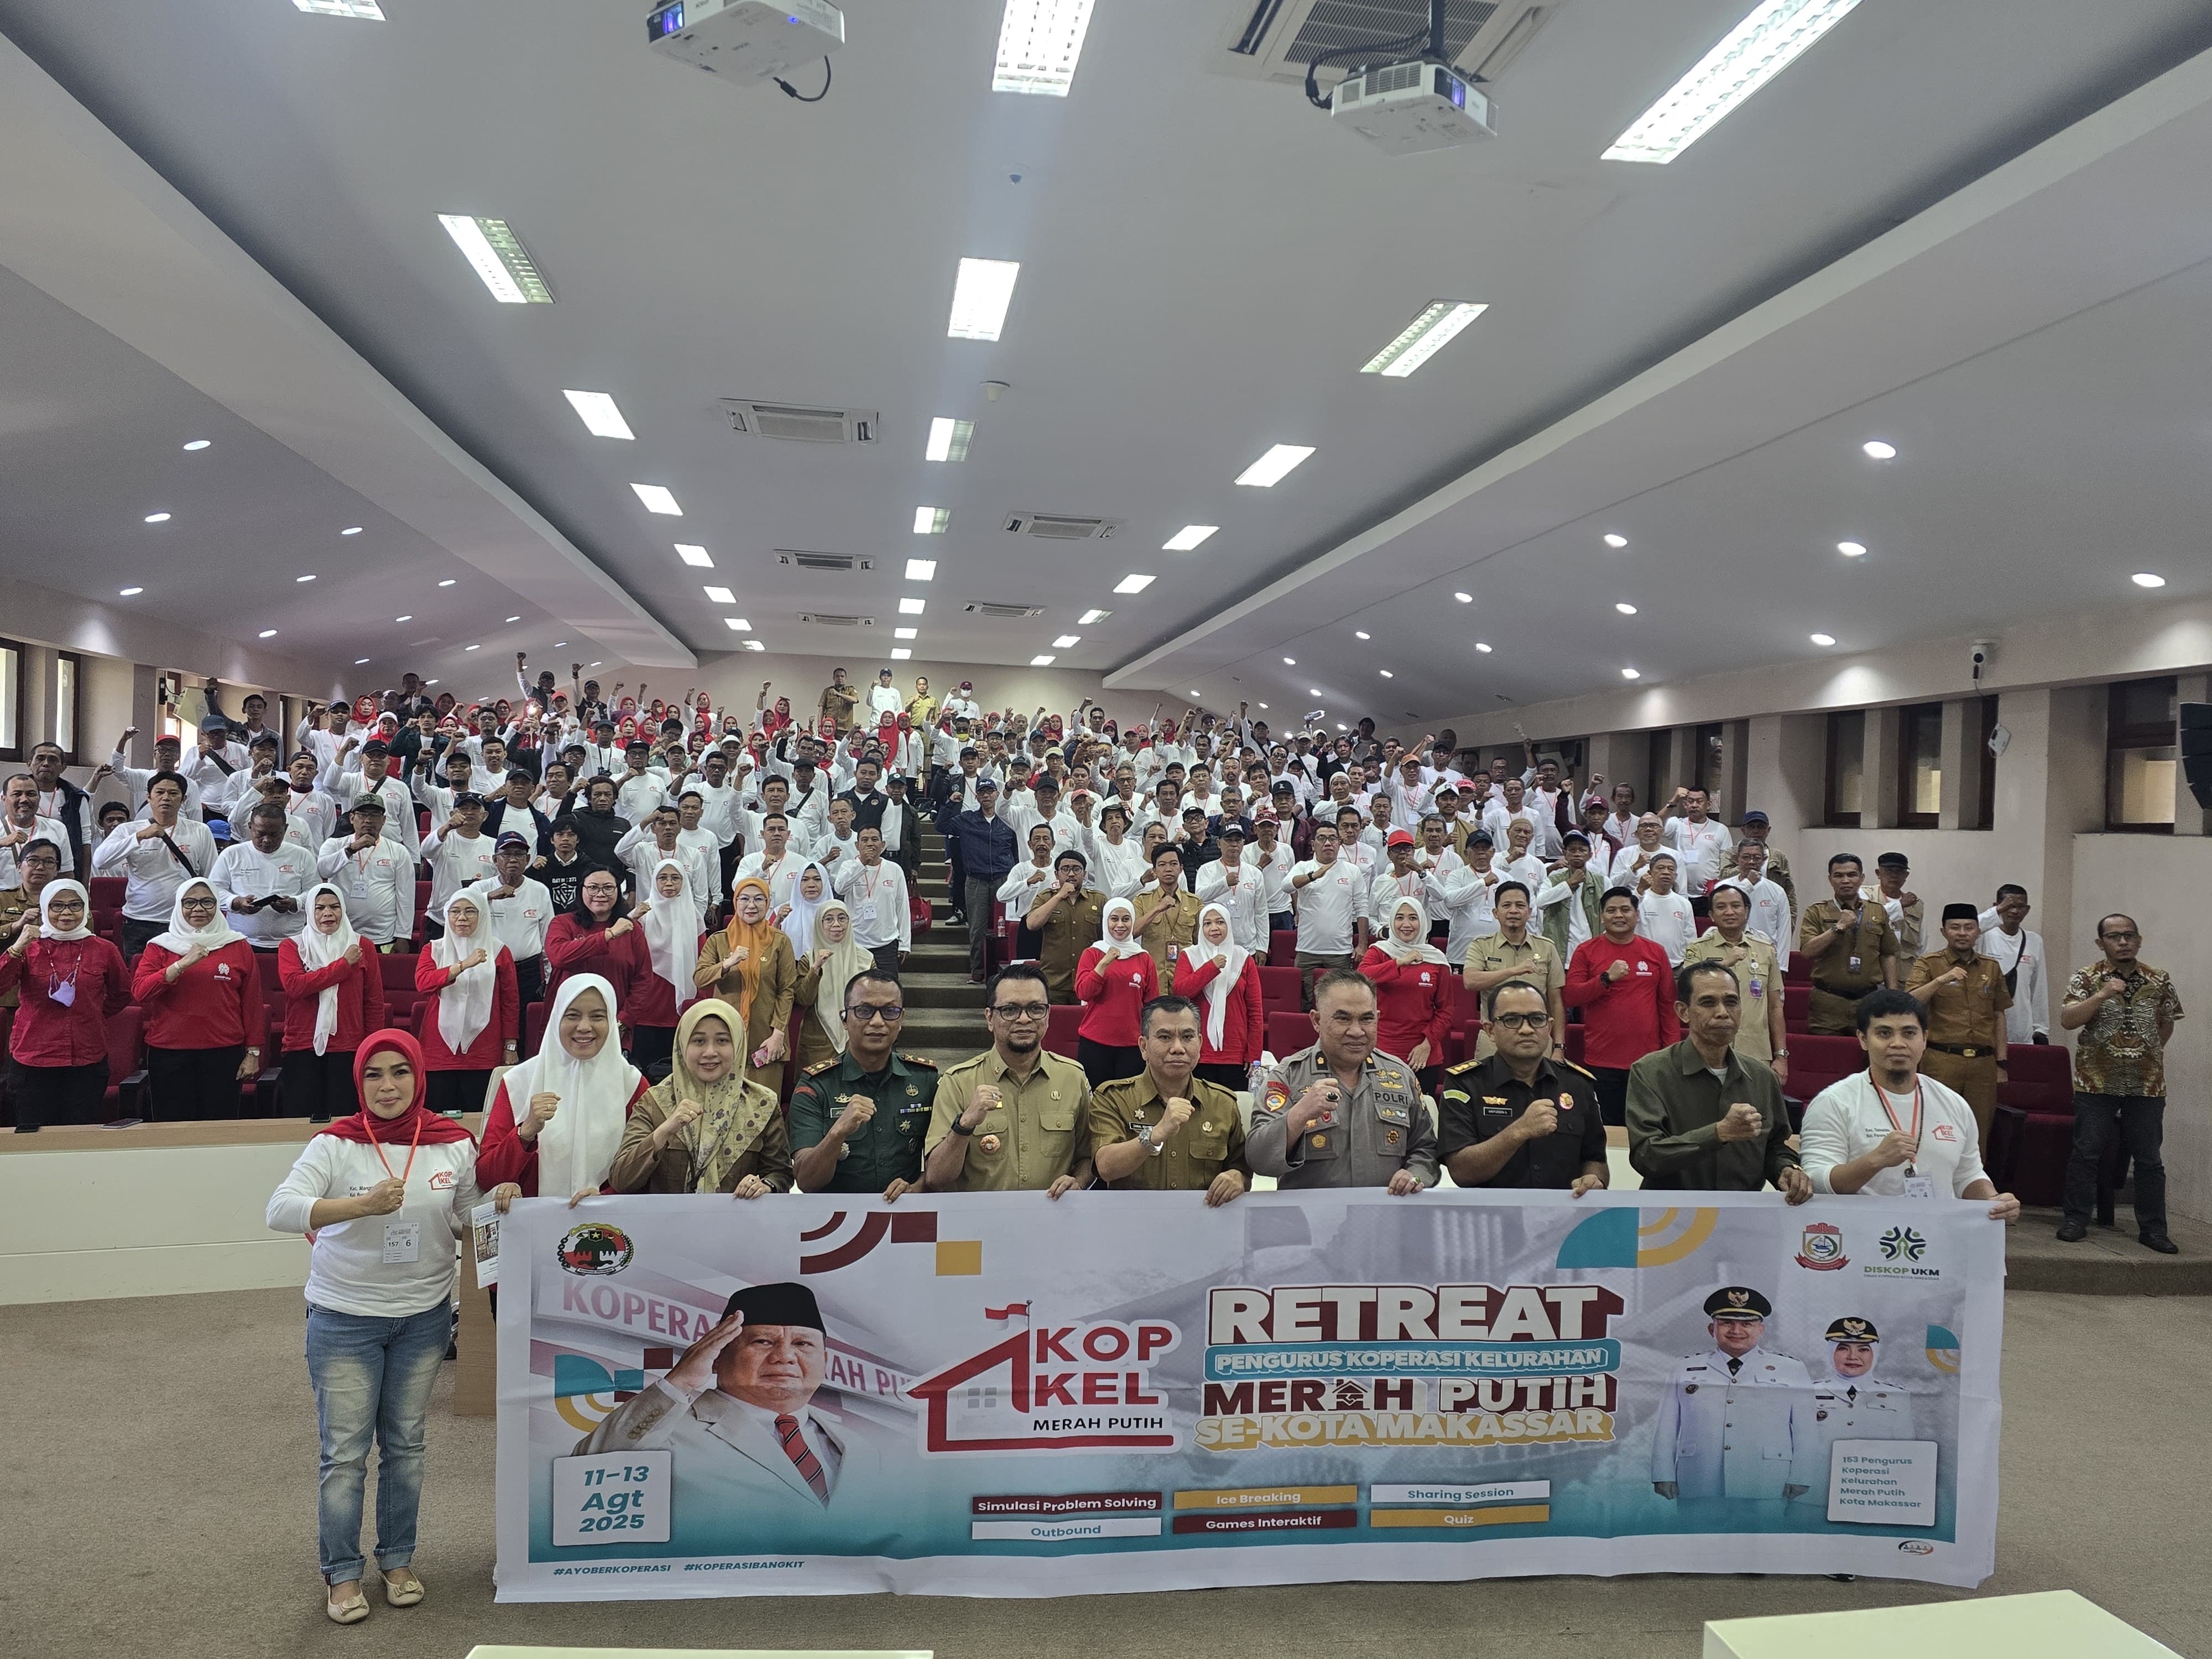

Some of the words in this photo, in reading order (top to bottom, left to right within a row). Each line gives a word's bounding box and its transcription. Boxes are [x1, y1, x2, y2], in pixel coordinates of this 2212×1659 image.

[1374, 1092, 1410, 1105] POLRI
[1864, 1265, 1910, 1274] DISKOP
[1911, 1267, 1939, 1276] UKM
[1208, 1285, 1625, 1345] RETREAT
[1036, 1326, 1172, 1364] KOP
[1215, 1352, 1344, 1374] PENGURUS
[1346, 1350, 1463, 1370] KOPERASI
[1463, 1348, 1608, 1369] KELURAHAN
[1035, 1371, 1159, 1407] KEL
[1439, 1375, 1618, 1413] PUTIH
[1033, 1418, 1100, 1432] MERAH
[1108, 1417, 1164, 1430] PUTIH
[1194, 1411, 1376, 1451] SE-KOTA
[1376, 1407, 1615, 1448] MAKASSAR
[1861, 1457, 1913, 1466] Pengurus
[1841, 1467, 1890, 1475] Koperasi
[1841, 1477, 1897, 1485] Kelurahan
[1216, 1494, 1237, 1505] Ice
[1239, 1491, 1301, 1505] Breaking
[1408, 1488, 1462, 1501] Sharing
[1464, 1486, 1514, 1499] Session
[1840, 1488, 1875, 1496] Merah
[581, 1489, 644, 1517] Agt
[978, 1500, 1041, 1512] Simulasi
[1042, 1498, 1102, 1512] Problem
[1104, 1496, 1157, 1511] Solving
[1839, 1498, 1865, 1506] Kota
[1867, 1499, 1922, 1507] Makassar
[578, 1514, 645, 1533] 2025
[1206, 1519, 1255, 1530] Games
[1258, 1515, 1322, 1528] Interaktif
[1443, 1514, 1474, 1526] Quiz
[1031, 1524, 1102, 1536] Outbound
[553, 1563, 671, 1577] #AYOBERKOPERASI
[684, 1560, 805, 1573] #KOPERASIBANGKIT
